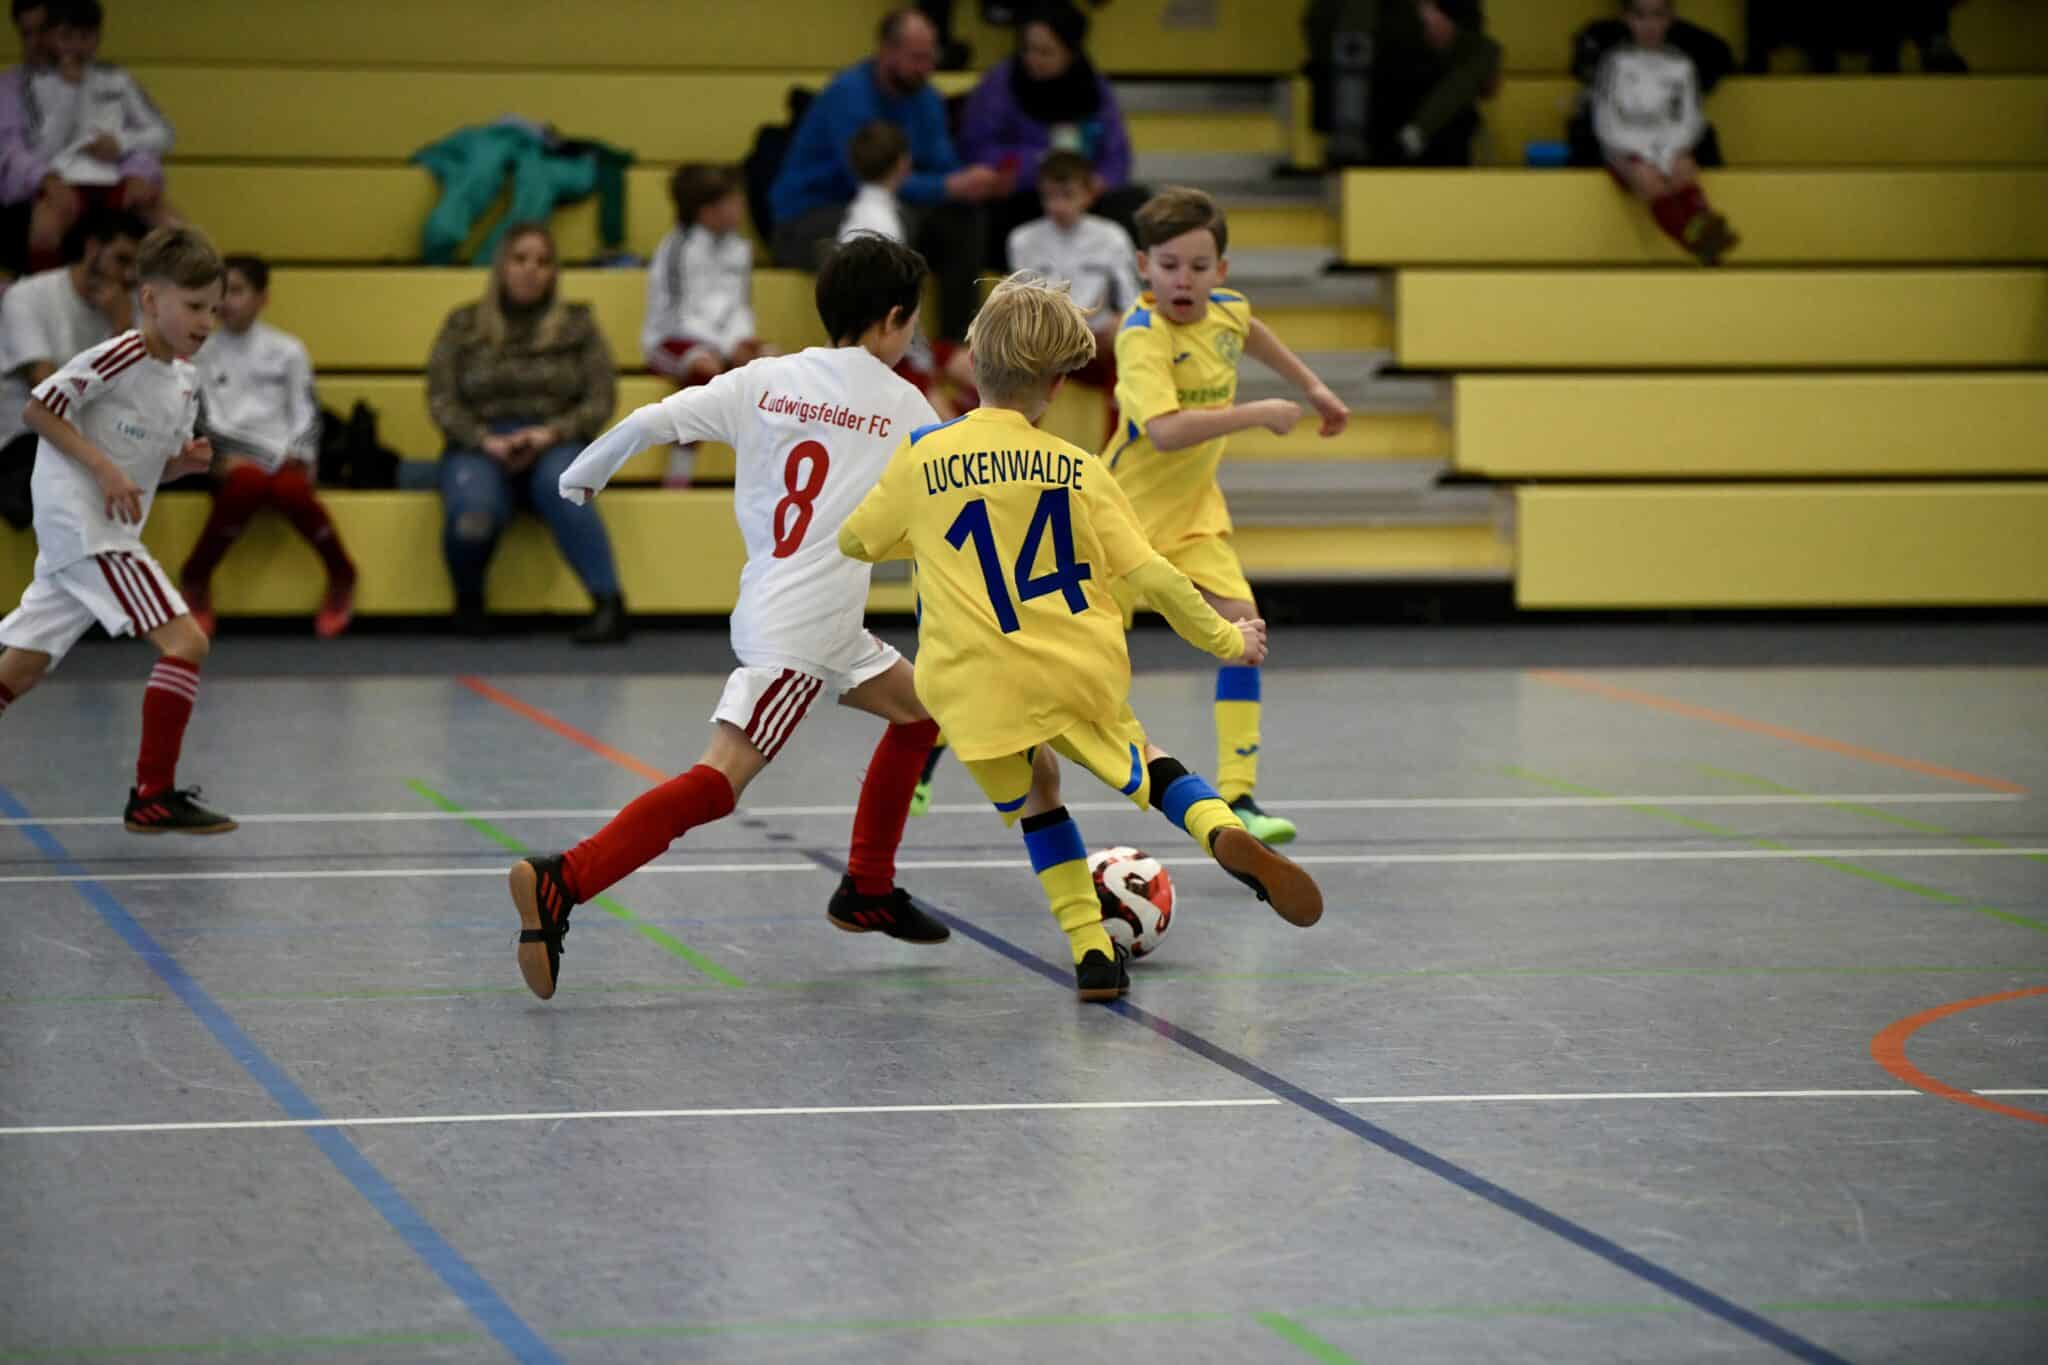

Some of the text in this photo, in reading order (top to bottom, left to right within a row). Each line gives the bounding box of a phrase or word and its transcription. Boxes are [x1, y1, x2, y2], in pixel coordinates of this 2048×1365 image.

[757, 390, 892, 438] Ludwigsfelder FC
[771, 440, 830, 558] 8
[923, 450, 1084, 496] LUCKENWALDE
[944, 486, 1092, 634] 14
